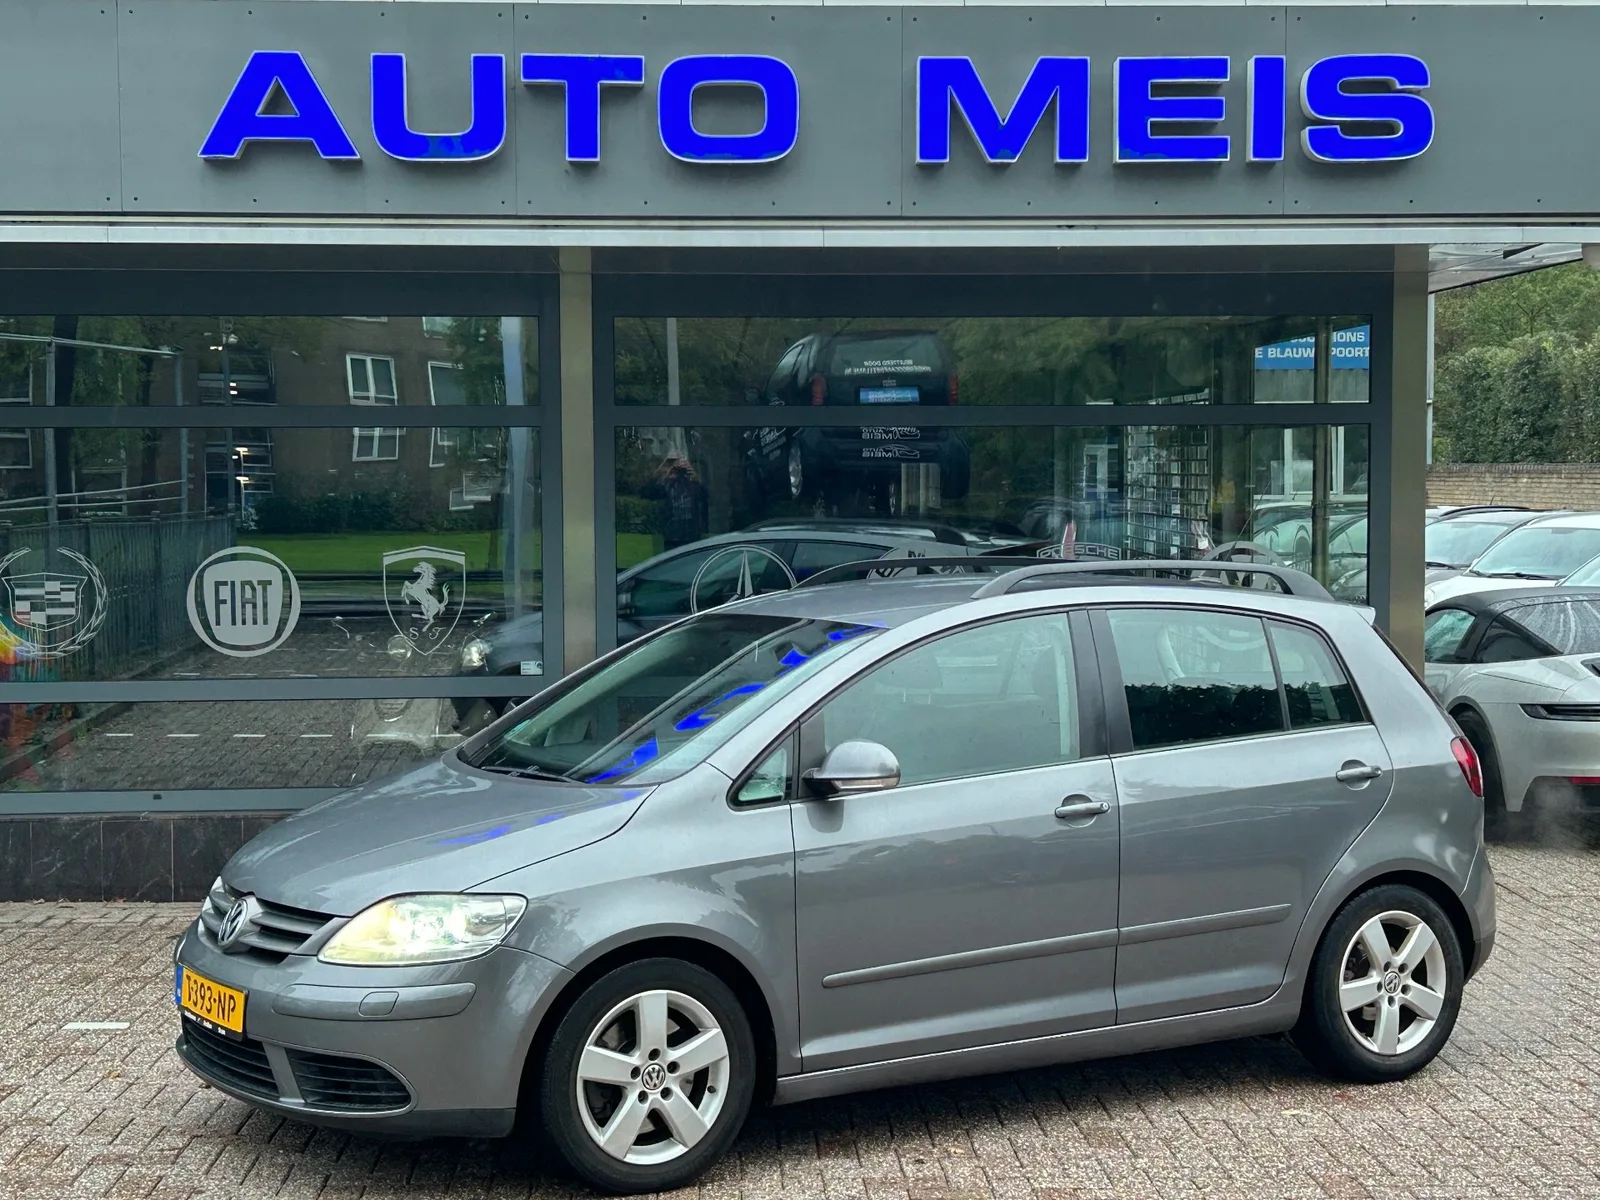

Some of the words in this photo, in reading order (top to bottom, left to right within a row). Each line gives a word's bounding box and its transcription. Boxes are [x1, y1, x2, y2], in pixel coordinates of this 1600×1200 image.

[197, 50, 800, 164] AUTO
[915, 53, 1436, 164] MEIS
[1268, 347, 1315, 358] BLAUW
[213, 579, 273, 627] FIAT
